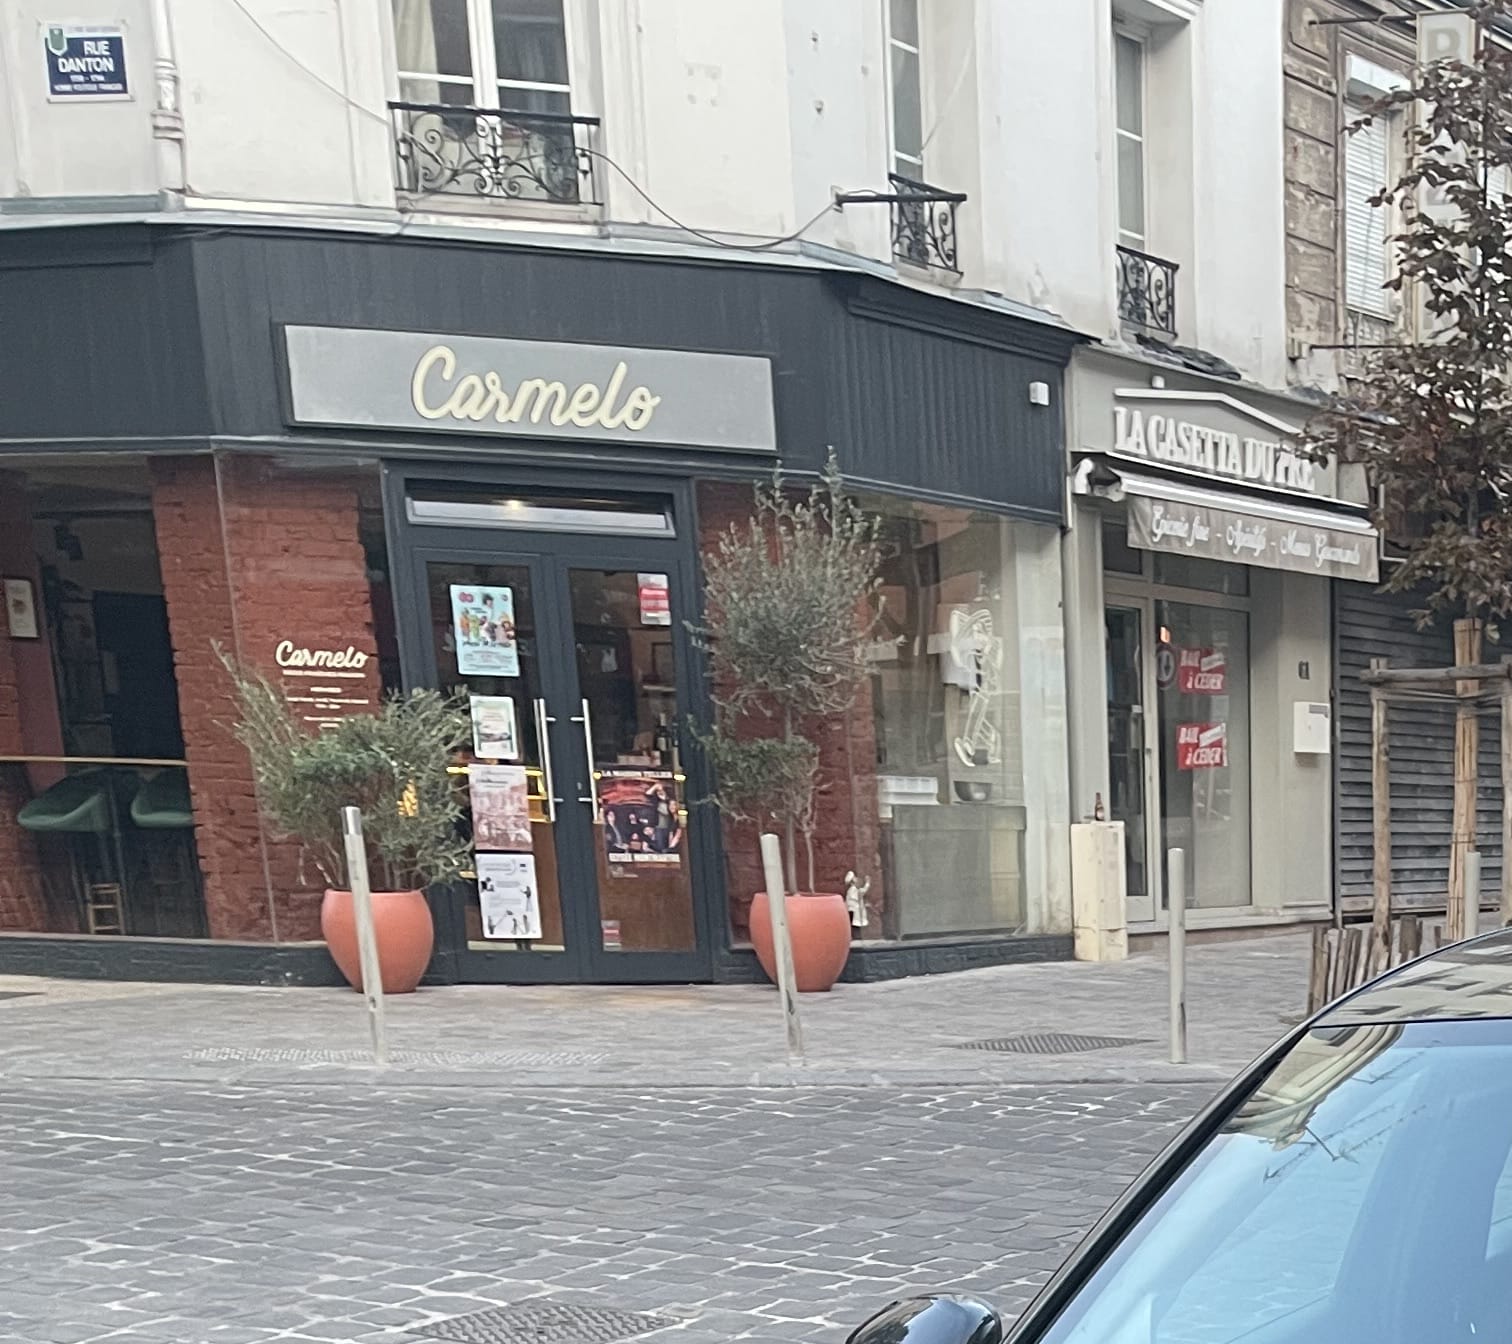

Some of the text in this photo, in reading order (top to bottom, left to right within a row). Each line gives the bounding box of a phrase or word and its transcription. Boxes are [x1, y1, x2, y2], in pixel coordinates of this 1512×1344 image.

[83, 40, 111, 56] RUE
[58, 57, 115, 73] DANTON
[411, 345, 662, 431] Carmelo
[1113, 406, 1148, 456] LA
[1147, 414, 1243, 476] CASETTA
[276, 640, 369, 669] Carmelo
